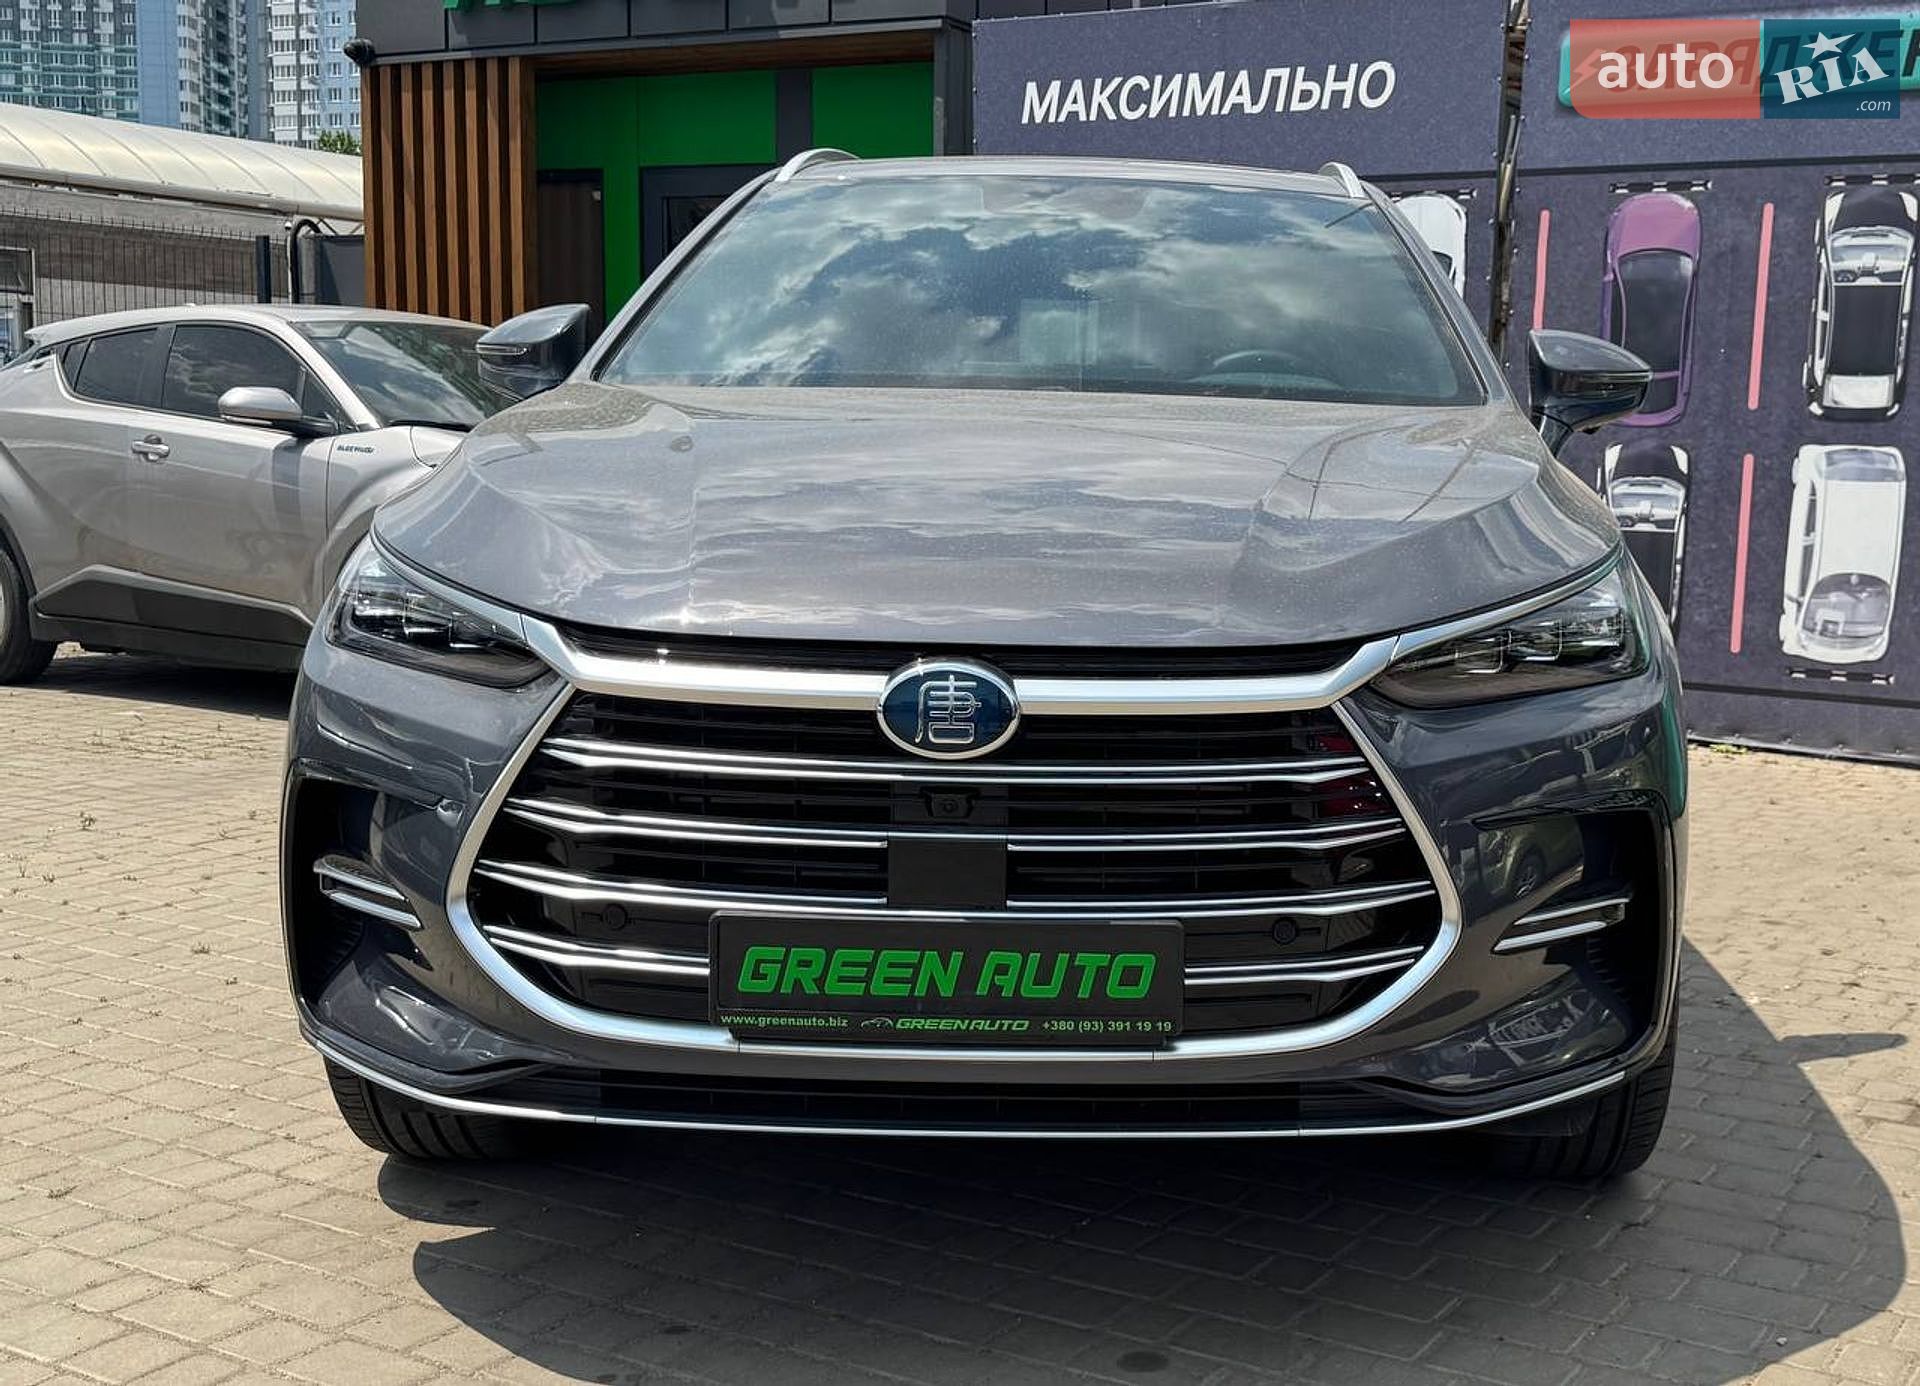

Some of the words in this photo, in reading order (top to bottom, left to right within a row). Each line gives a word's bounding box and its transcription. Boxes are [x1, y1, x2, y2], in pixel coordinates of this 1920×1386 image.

[1021, 61, 1396, 125] МАКСИМАЛЬНО
[737, 946, 964, 997] GREEN
[975, 951, 1157, 999] AUTO
[720, 1014, 849, 1028] www.greenauto.biz
[895, 1018, 1031, 1031] GREENAUTO
[1042, 1020, 1075, 1031] +380
[1078, 1020, 1104, 1033] (93)
[1108, 1021, 1131, 1031] 391
[1136, 1021, 1152, 1032] 19
[1157, 1022, 1172, 1032] 19
